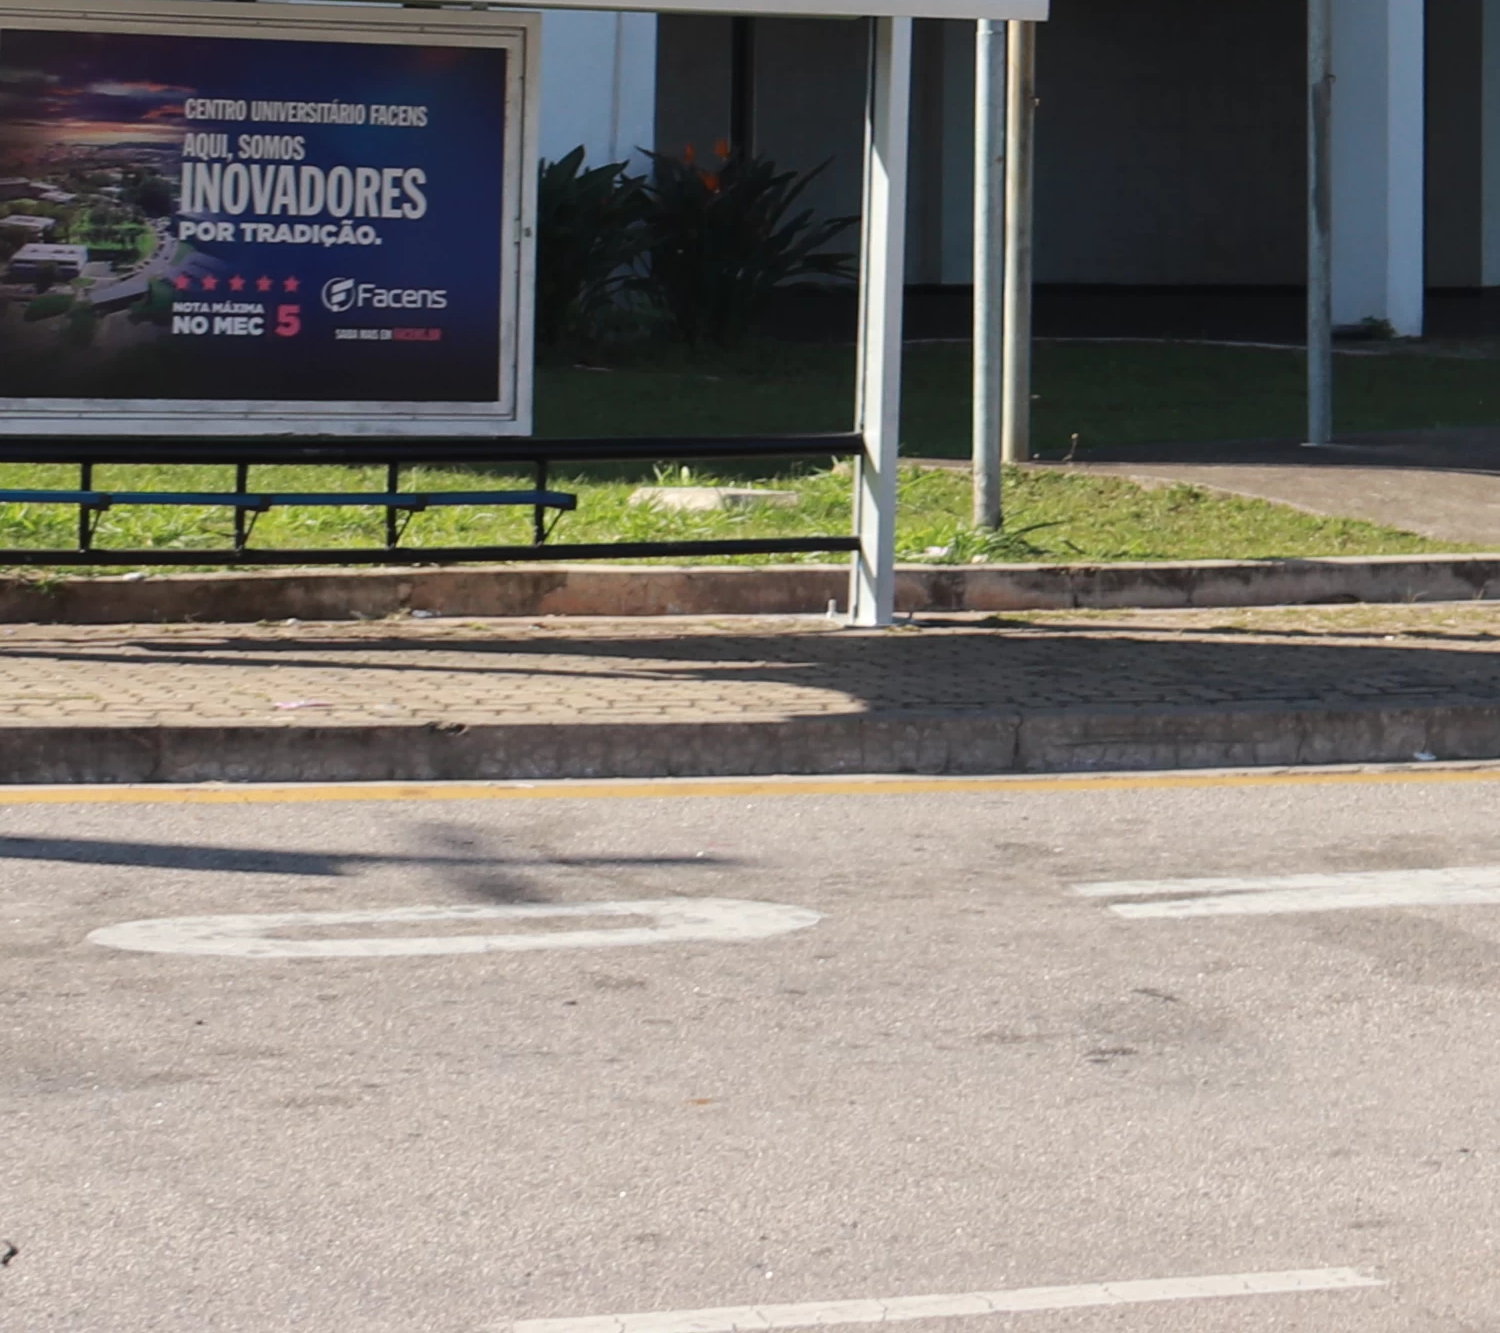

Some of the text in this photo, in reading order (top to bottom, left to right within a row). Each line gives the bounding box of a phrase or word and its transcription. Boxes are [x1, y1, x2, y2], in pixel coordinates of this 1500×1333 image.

[184, 98, 428, 126] CENTRO UNIVERSITÁRIO FACENS
[182, 133, 305, 162] AQUI, SOMOS
[180, 161, 428, 219] INOVADORES
[179, 219, 382, 247] POR TRADIÇÃO.
[172, 300, 265, 314] NOTA MÁXIMA
[356, 283, 447, 309] Facens
[172, 315, 265, 336] NO MEC
[275, 304, 301, 337] 5
